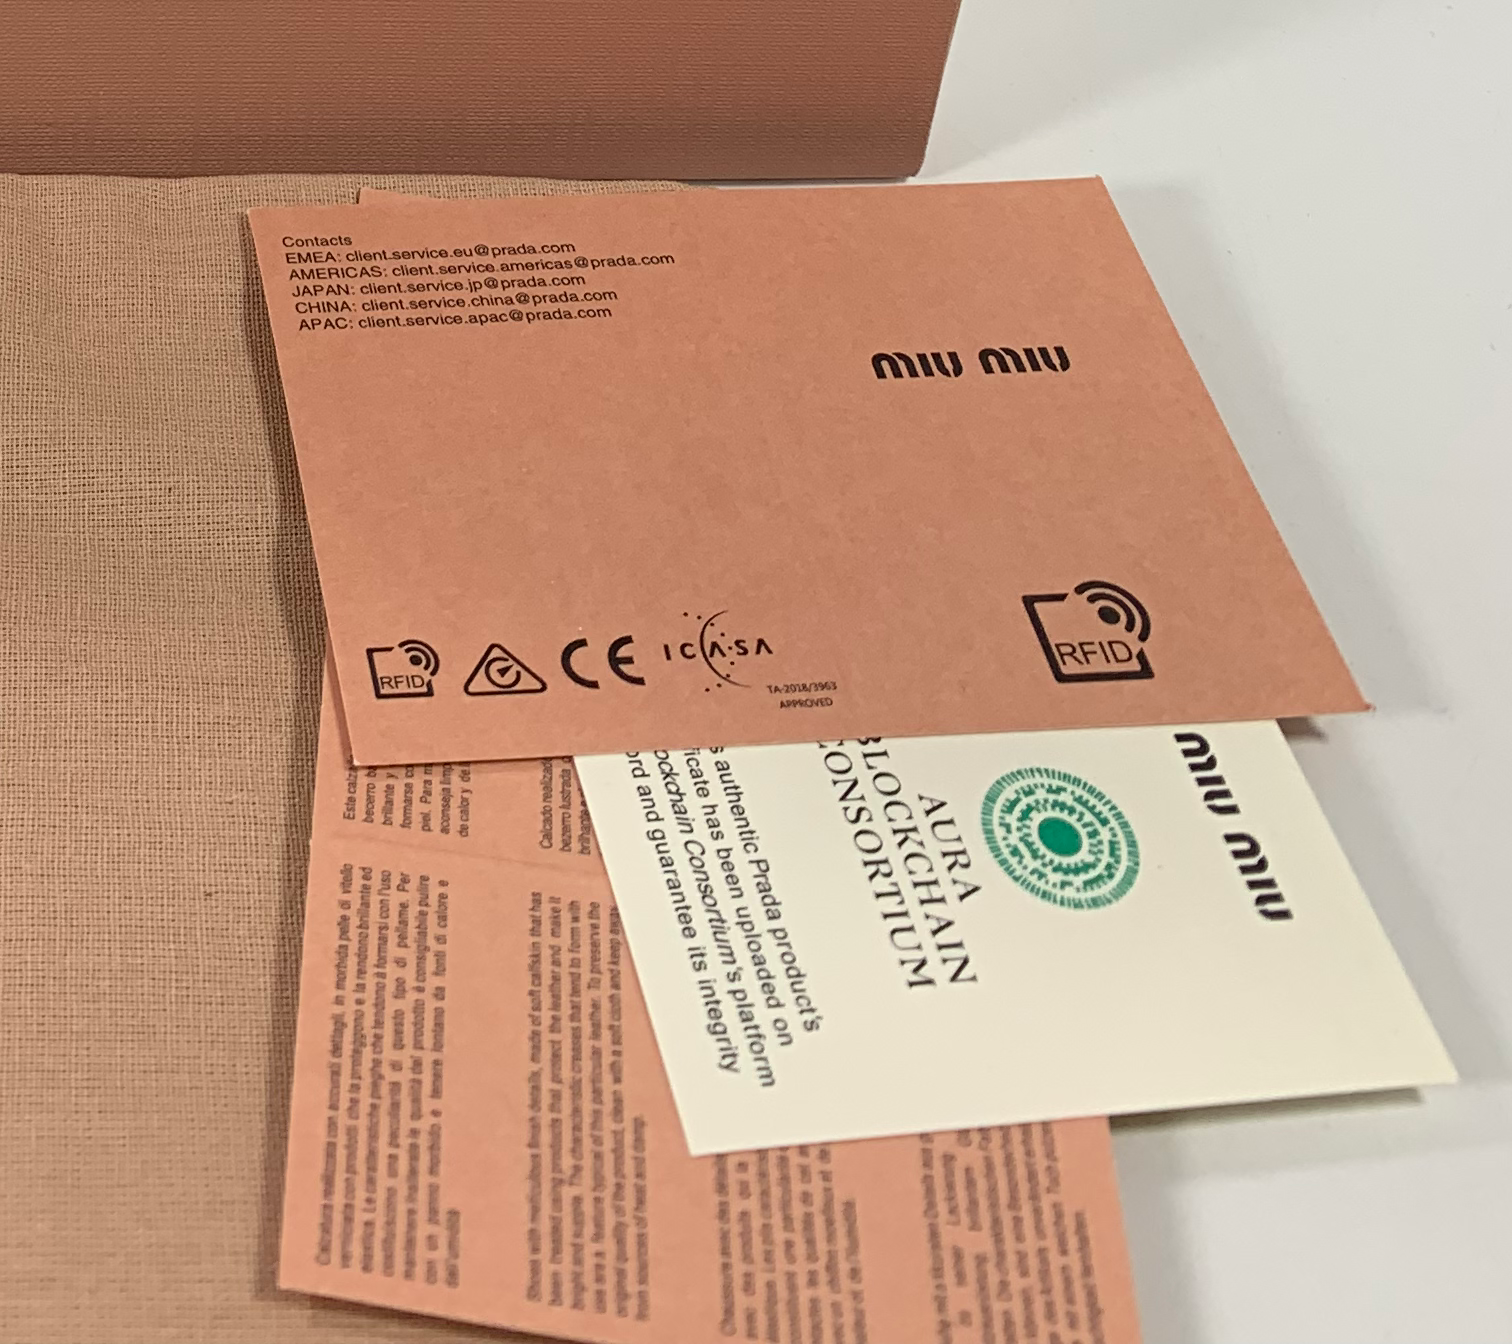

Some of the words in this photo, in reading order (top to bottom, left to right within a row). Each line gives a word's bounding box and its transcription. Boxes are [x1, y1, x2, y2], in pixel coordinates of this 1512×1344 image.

[282, 235, 352, 248] Contacts
[285, 251, 341, 264] EMEA:
[346, 243, 576, 262] client.service.eu@prada.com
[289, 265, 387, 281] AMERICAS:
[392, 253, 675, 277] client.service.americas@prada.com
[291, 284, 355, 297] JAPAN:
[360, 274, 586, 294] client.service.jp@prada.com
[295, 300, 356, 314] CHINA:
[361, 289, 618, 312] client.service.china@prada.com
[299, 316, 354, 331] APAC:
[358, 306, 612, 329] client.service.apac@prada.com
[1054, 639, 1134, 666] RFID
[379, 674, 425, 690] RFID
[780, 697, 833, 709] APPROVED
[362, 783, 376, 824] becerro
[381, 784, 395, 826] brillante
[419, 779, 432, 804] Para
[636, 785, 665, 823] and
[342, 796, 356, 821] Este
[400, 783, 413, 830] formarse
[439, 788, 454, 835] aconseja
[456, 796, 469, 822] calor
[420, 810, 433, 832] piel.
[456, 823, 469, 838] de
[559, 812, 572, 853] bezerro
[918, 791, 982, 903] AURA
[340, 863, 354, 894] vitello
[359, 867, 373, 881] ed
[816, 740, 938, 990] ONSORTIUM
[396, 872, 411, 893] Per
[646, 828, 697, 940] guarantee
[714, 760, 760, 854] authentic
[748, 859, 782, 921] Prada
[767, 927, 823, 1032] product's
[338, 900, 351, 910] di
[356, 884, 371, 930] brillante
[378, 899, 390, 920] con
[434, 892, 448, 928] calore
[529, 891, 542, 912] has
[587, 902, 600, 920] the
[549, 906, 562, 938] make
[701, 804, 725, 841] has
[716, 847, 744, 899] been
[735, 906, 786, 1009] uploaded
[772, 1018, 794, 1046] on
[374, 922, 389, 970] formarsi
[687, 945, 708, 973] its
[684, 840, 744, 983] Consortium's
[726, 988, 776, 1088] platform
[697, 978, 741, 1074] integrity
